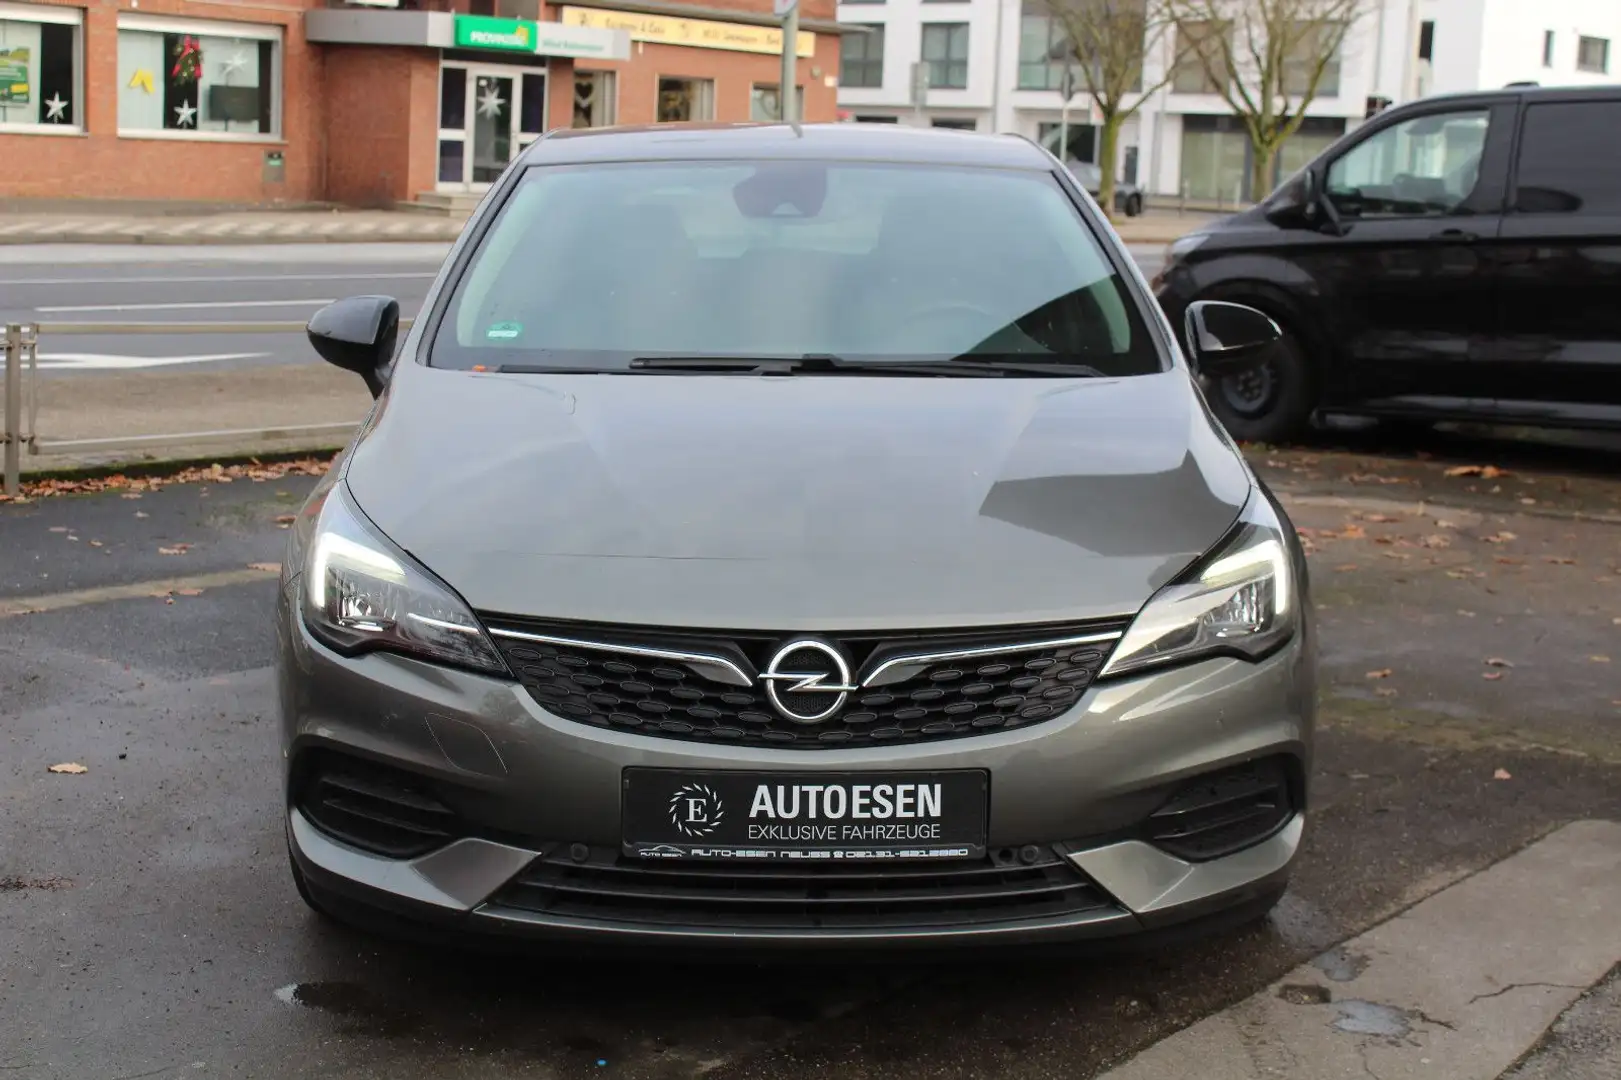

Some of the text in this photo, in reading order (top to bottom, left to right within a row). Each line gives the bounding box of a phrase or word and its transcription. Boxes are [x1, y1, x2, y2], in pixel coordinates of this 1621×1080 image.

[685, 798, 708, 822] E
[748, 823, 941, 840] EXKLUSIVE FAHRZEUGE
